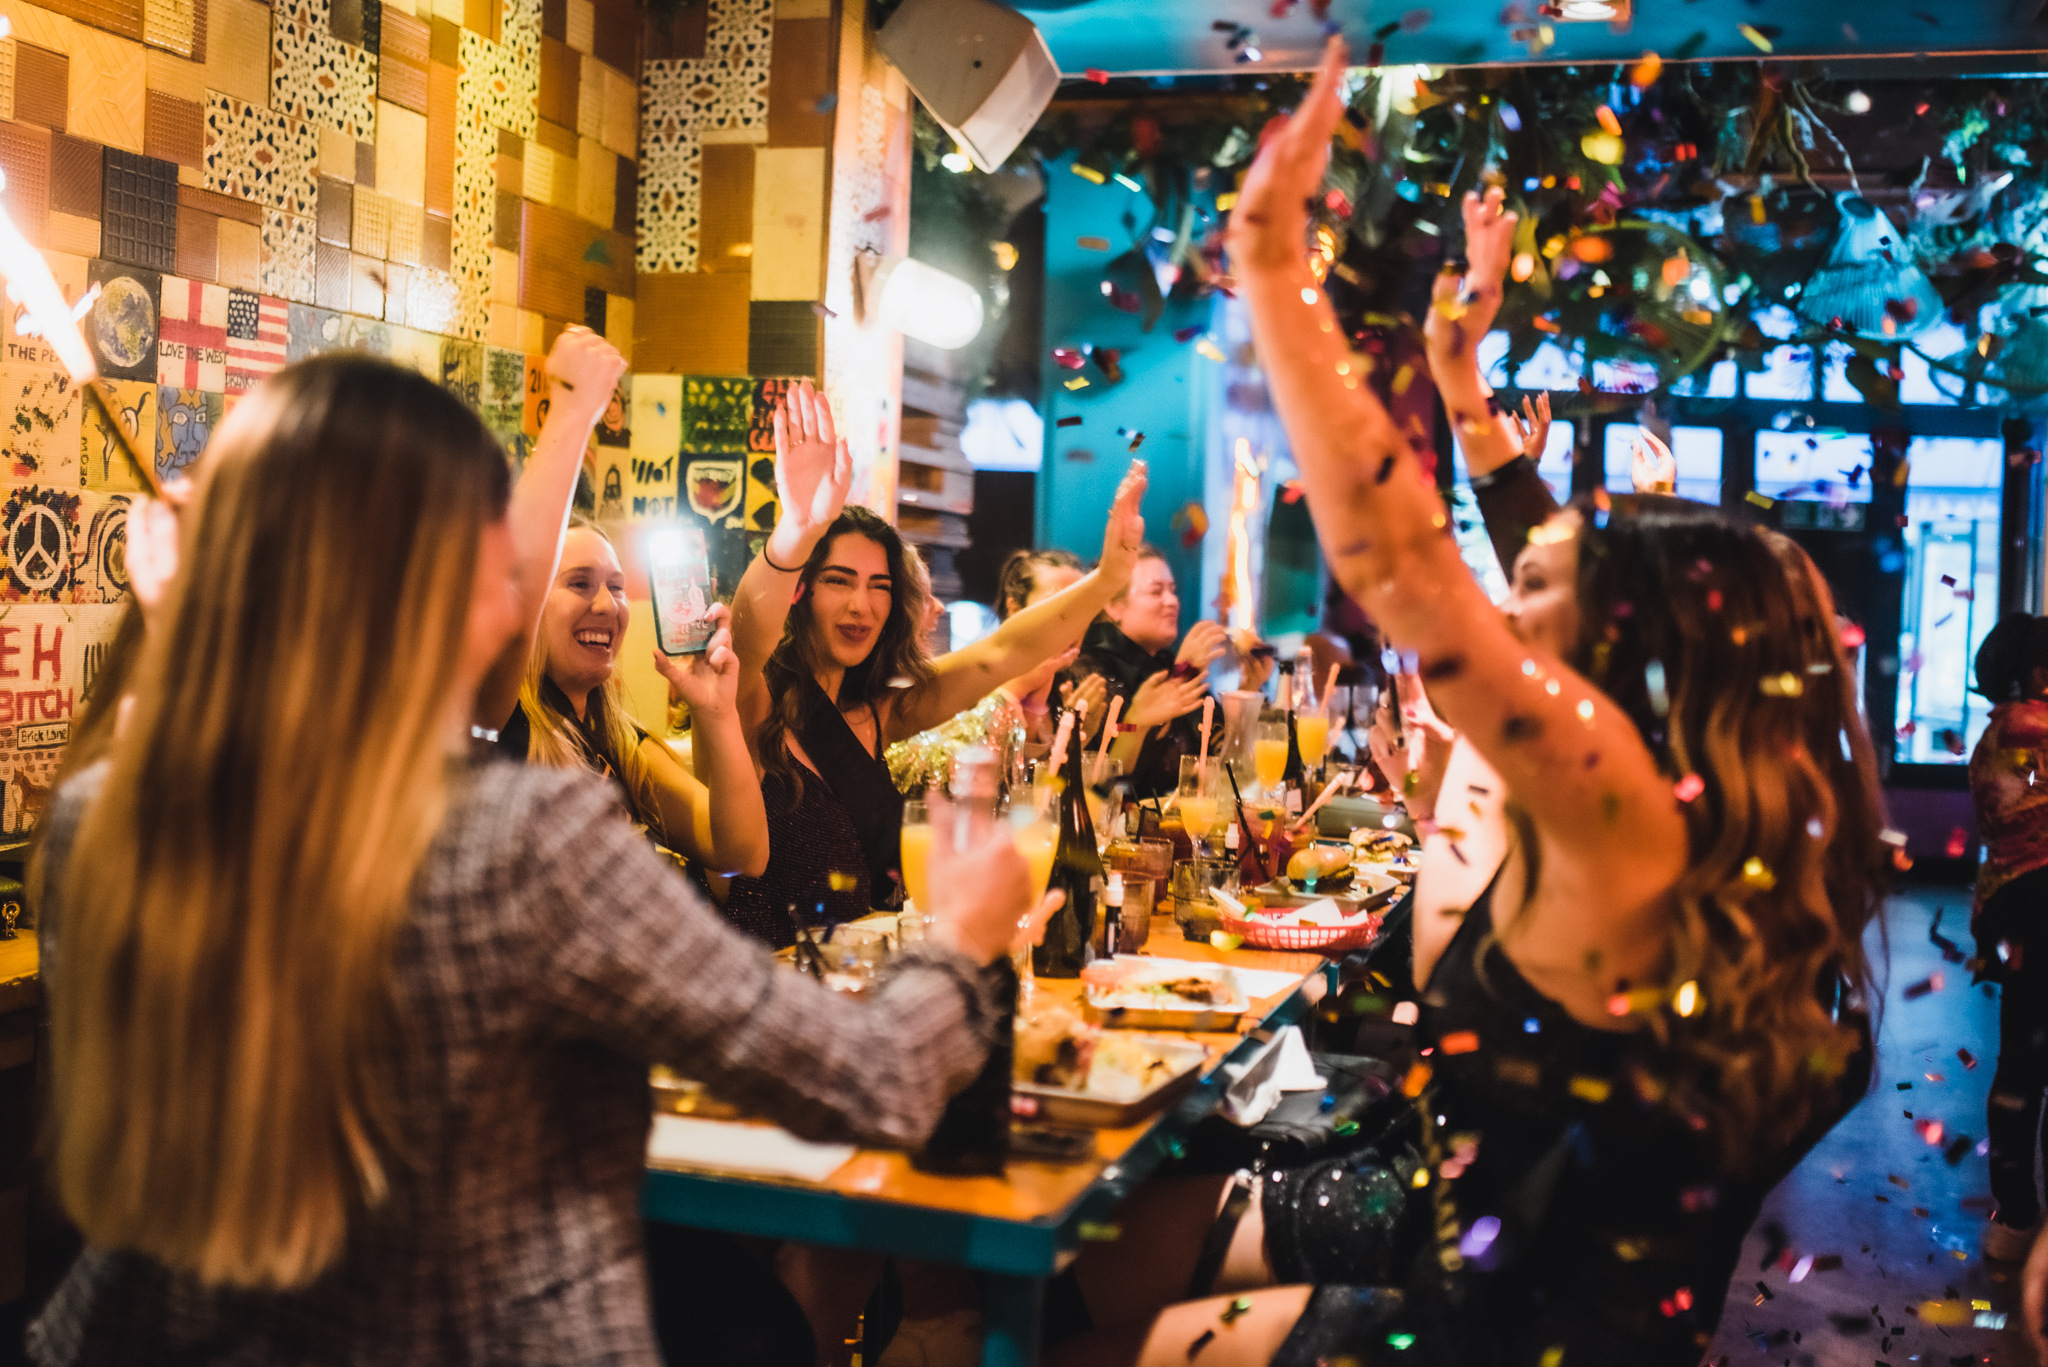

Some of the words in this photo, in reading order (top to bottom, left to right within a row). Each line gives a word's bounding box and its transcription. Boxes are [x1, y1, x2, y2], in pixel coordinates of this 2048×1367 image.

[8, 343, 37, 361] THE
[159, 341, 185, 360] LOVE
[186, 346, 203, 362] THE
[205, 349, 229, 364] WEST
[21, 730, 44, 742] Brick
